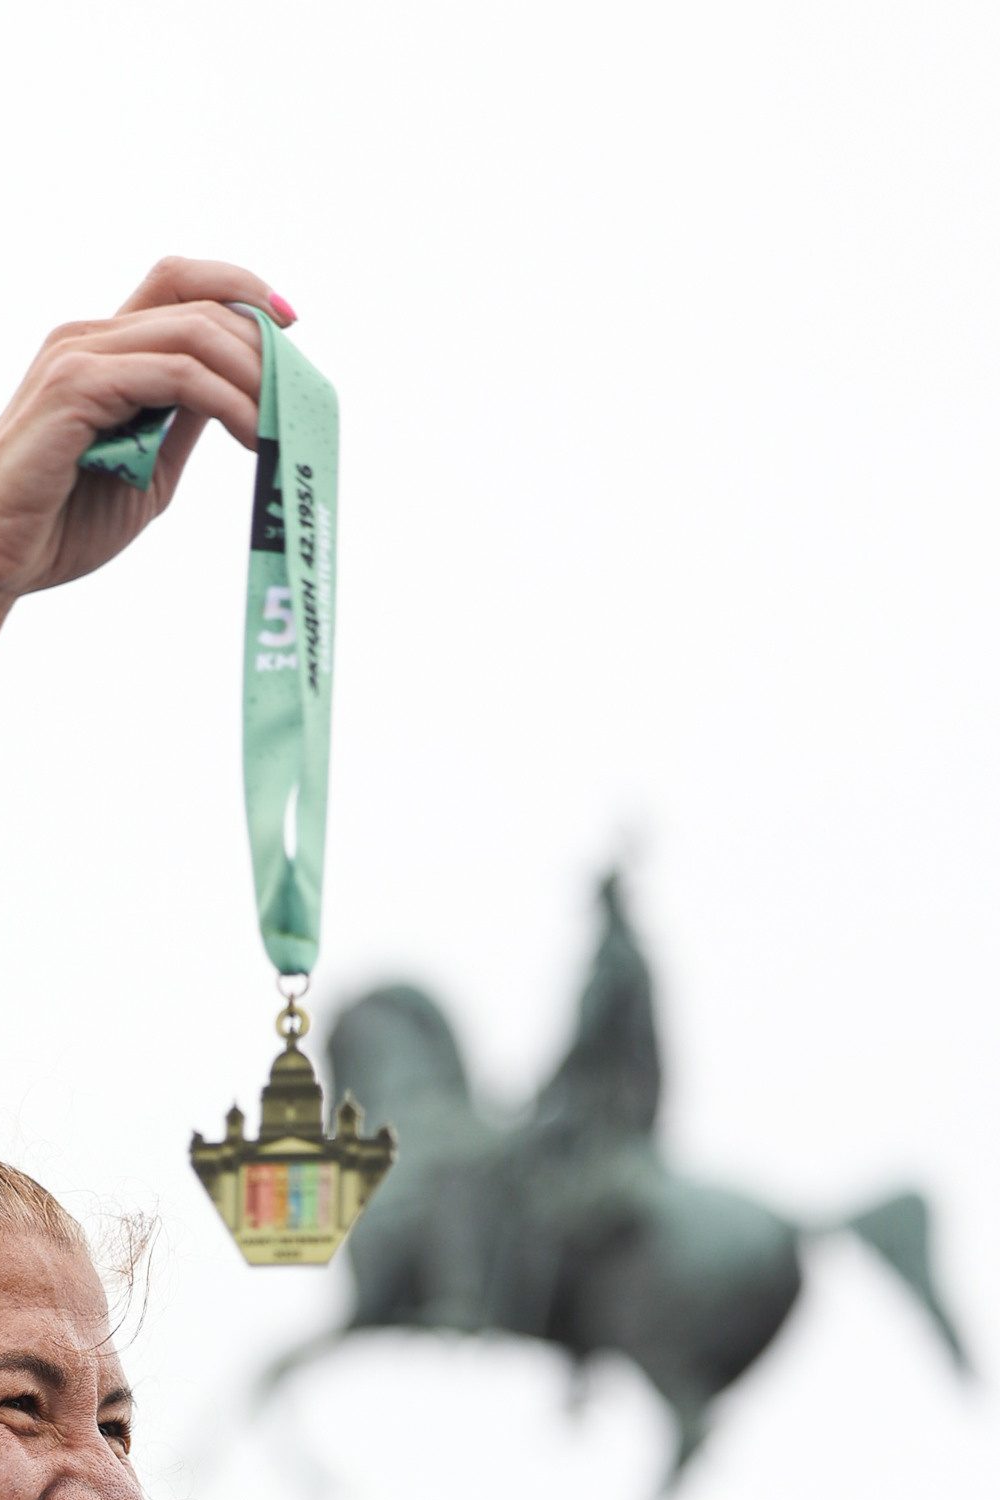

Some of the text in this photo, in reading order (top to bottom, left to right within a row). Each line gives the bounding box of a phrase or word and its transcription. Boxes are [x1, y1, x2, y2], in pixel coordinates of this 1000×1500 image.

[257, 585, 297, 648] 5
[296, 462, 320, 698] ЭКИДЕН 42.195/6
